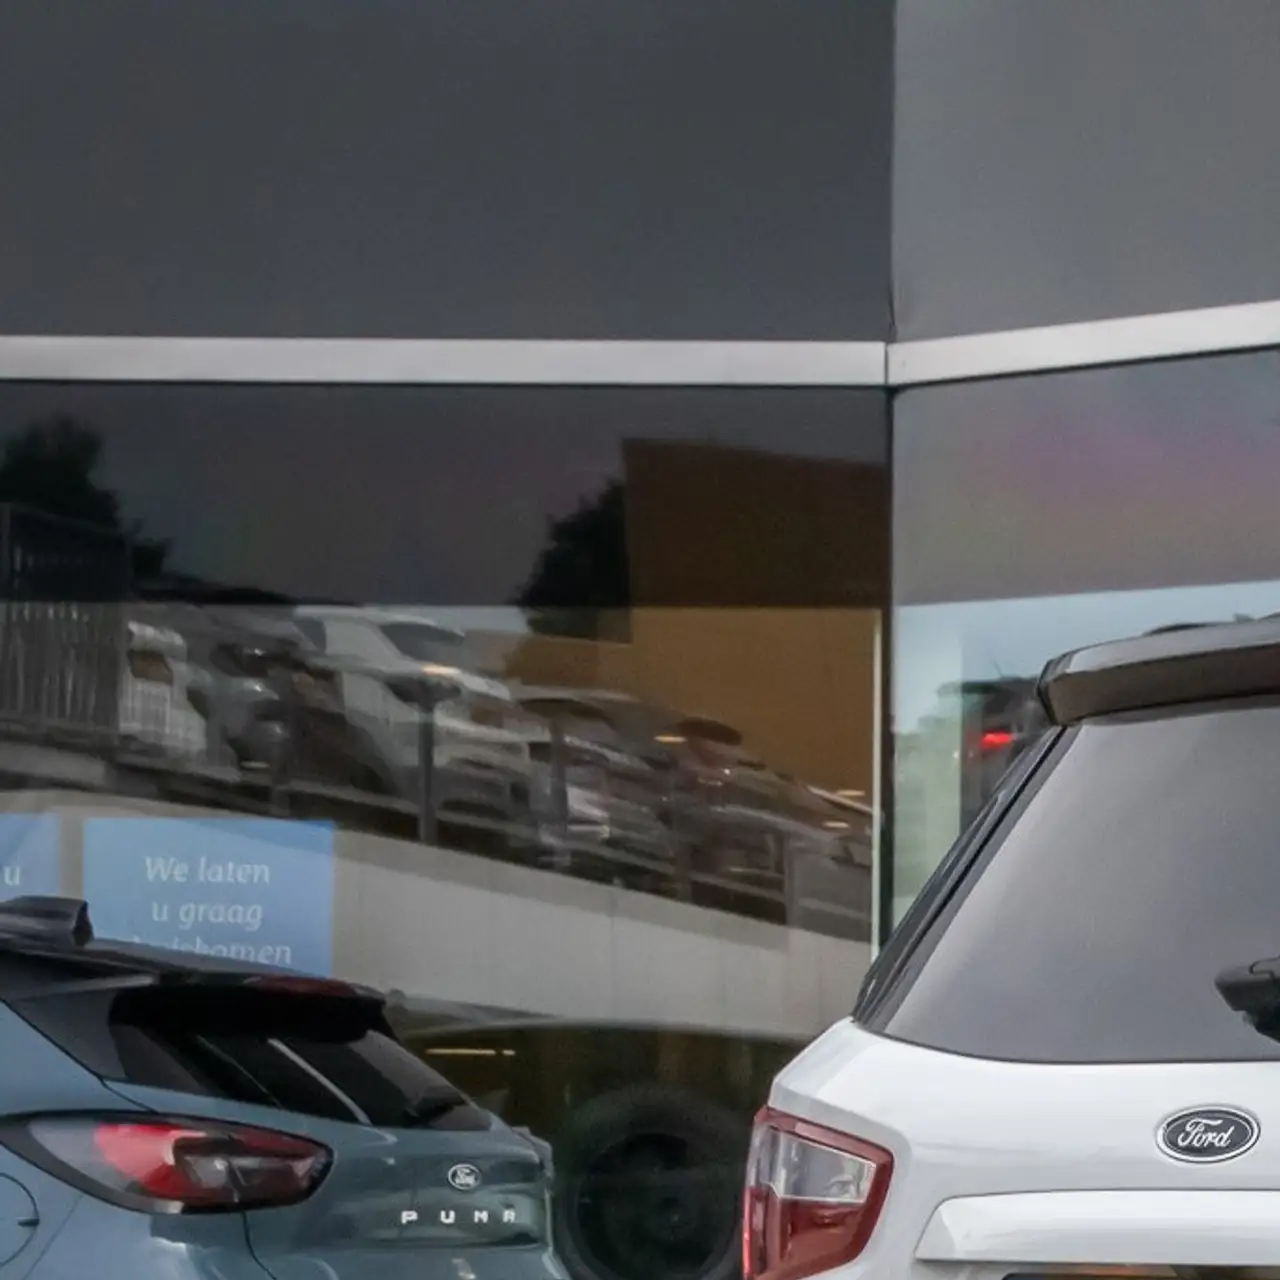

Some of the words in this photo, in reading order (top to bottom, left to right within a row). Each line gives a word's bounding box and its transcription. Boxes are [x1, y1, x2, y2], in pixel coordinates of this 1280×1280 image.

[144, 856, 188, 883] We
[199, 855, 270, 884] laten
[151, 902, 169, 922] u
[178, 902, 263, 931] graag
[1177, 1117, 1235, 1148] Ford
[401, 1209, 516, 1225] PUMA
